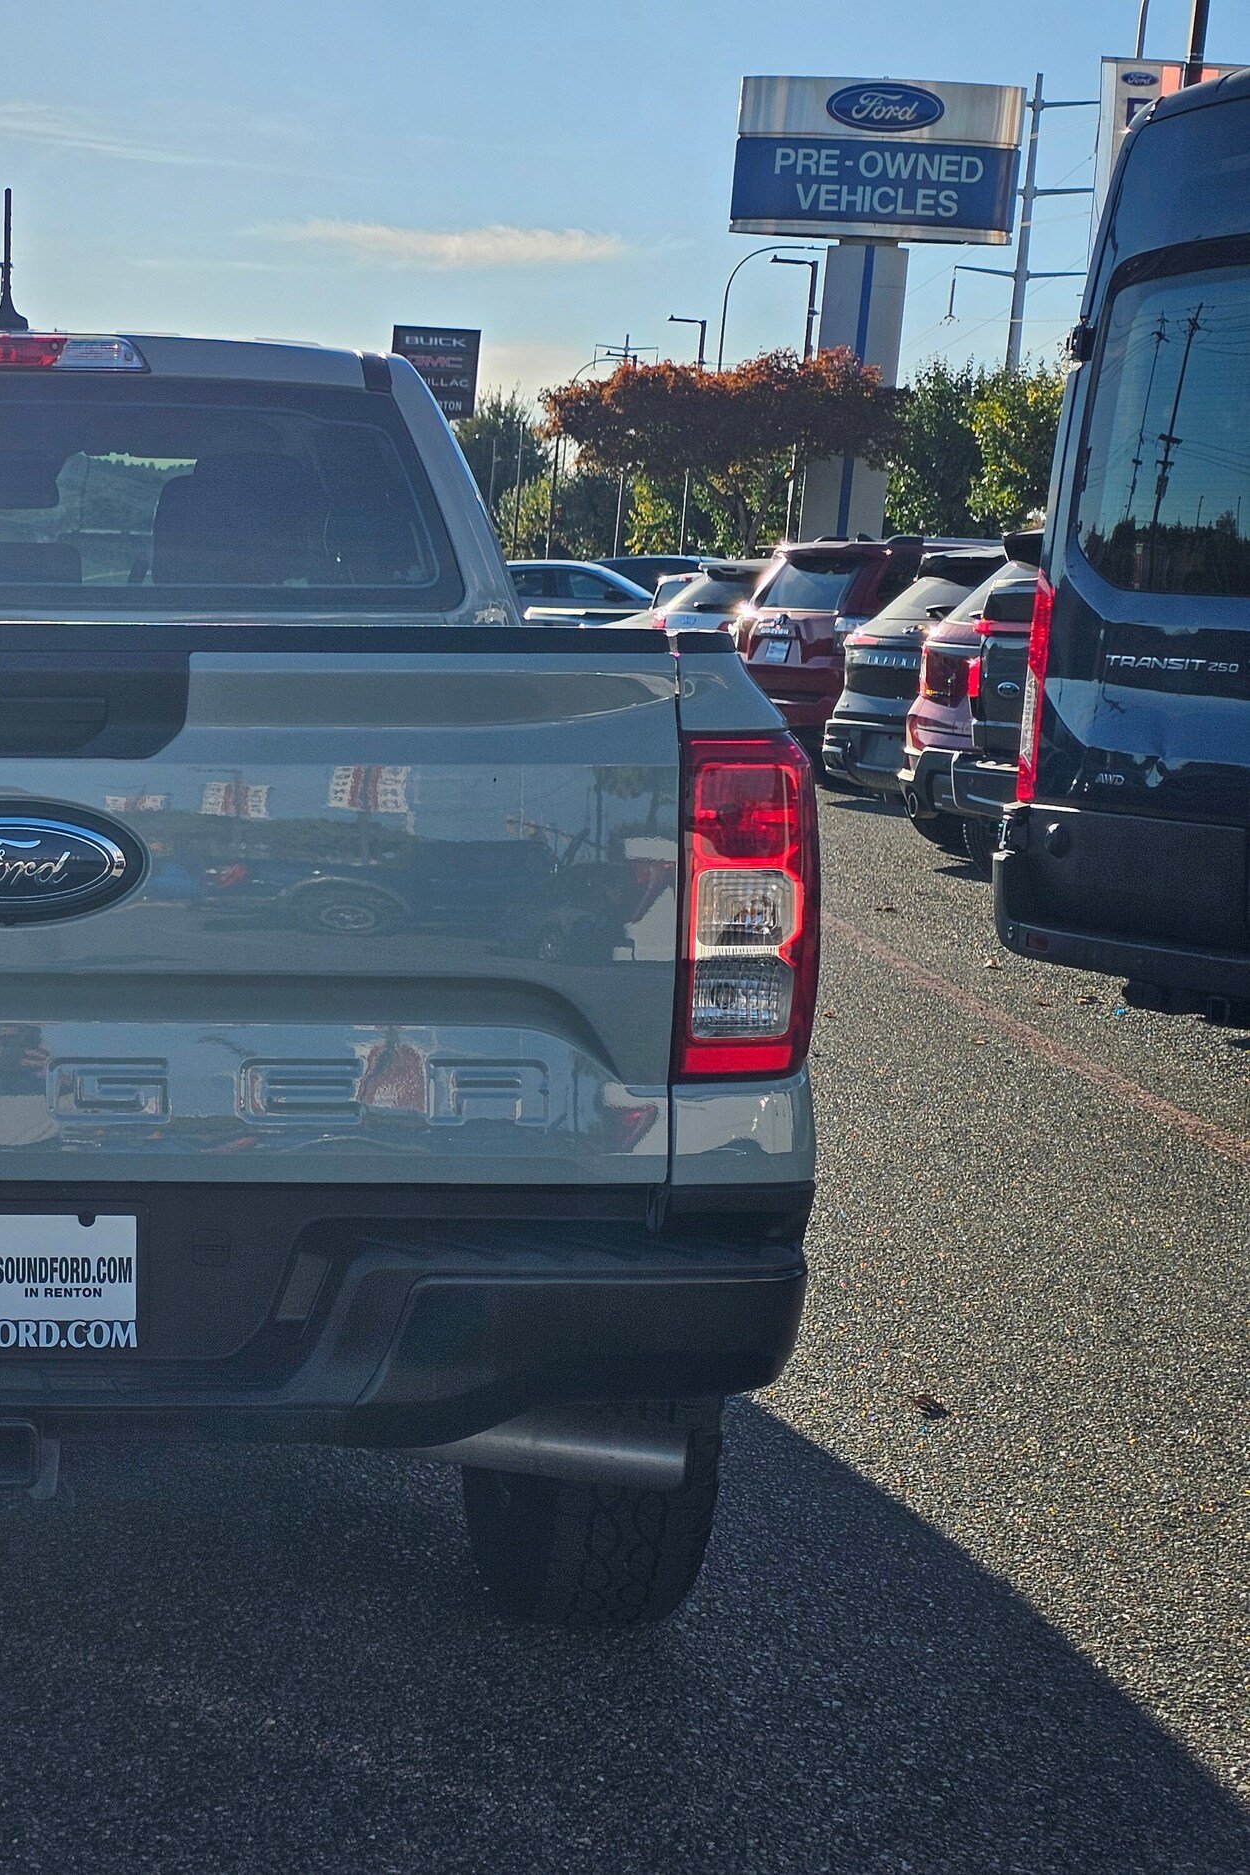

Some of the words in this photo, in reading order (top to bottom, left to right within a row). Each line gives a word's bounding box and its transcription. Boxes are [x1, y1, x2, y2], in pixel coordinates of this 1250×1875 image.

[851, 91, 918, 123] Ford
[796, 183, 959, 218] VEHICLES
[405, 336, 467, 348] BUICK
[407, 354, 464, 368] GMC
[424, 377, 469, 388] ILLAC
[1105, 654, 1207, 671] TRANSIT
[1207, 661, 1240, 673] 250
[1095, 773, 1125, 786] AWD
[24, 1287, 39, 1298] IN
[44, 1287, 103, 1298] RENTON
